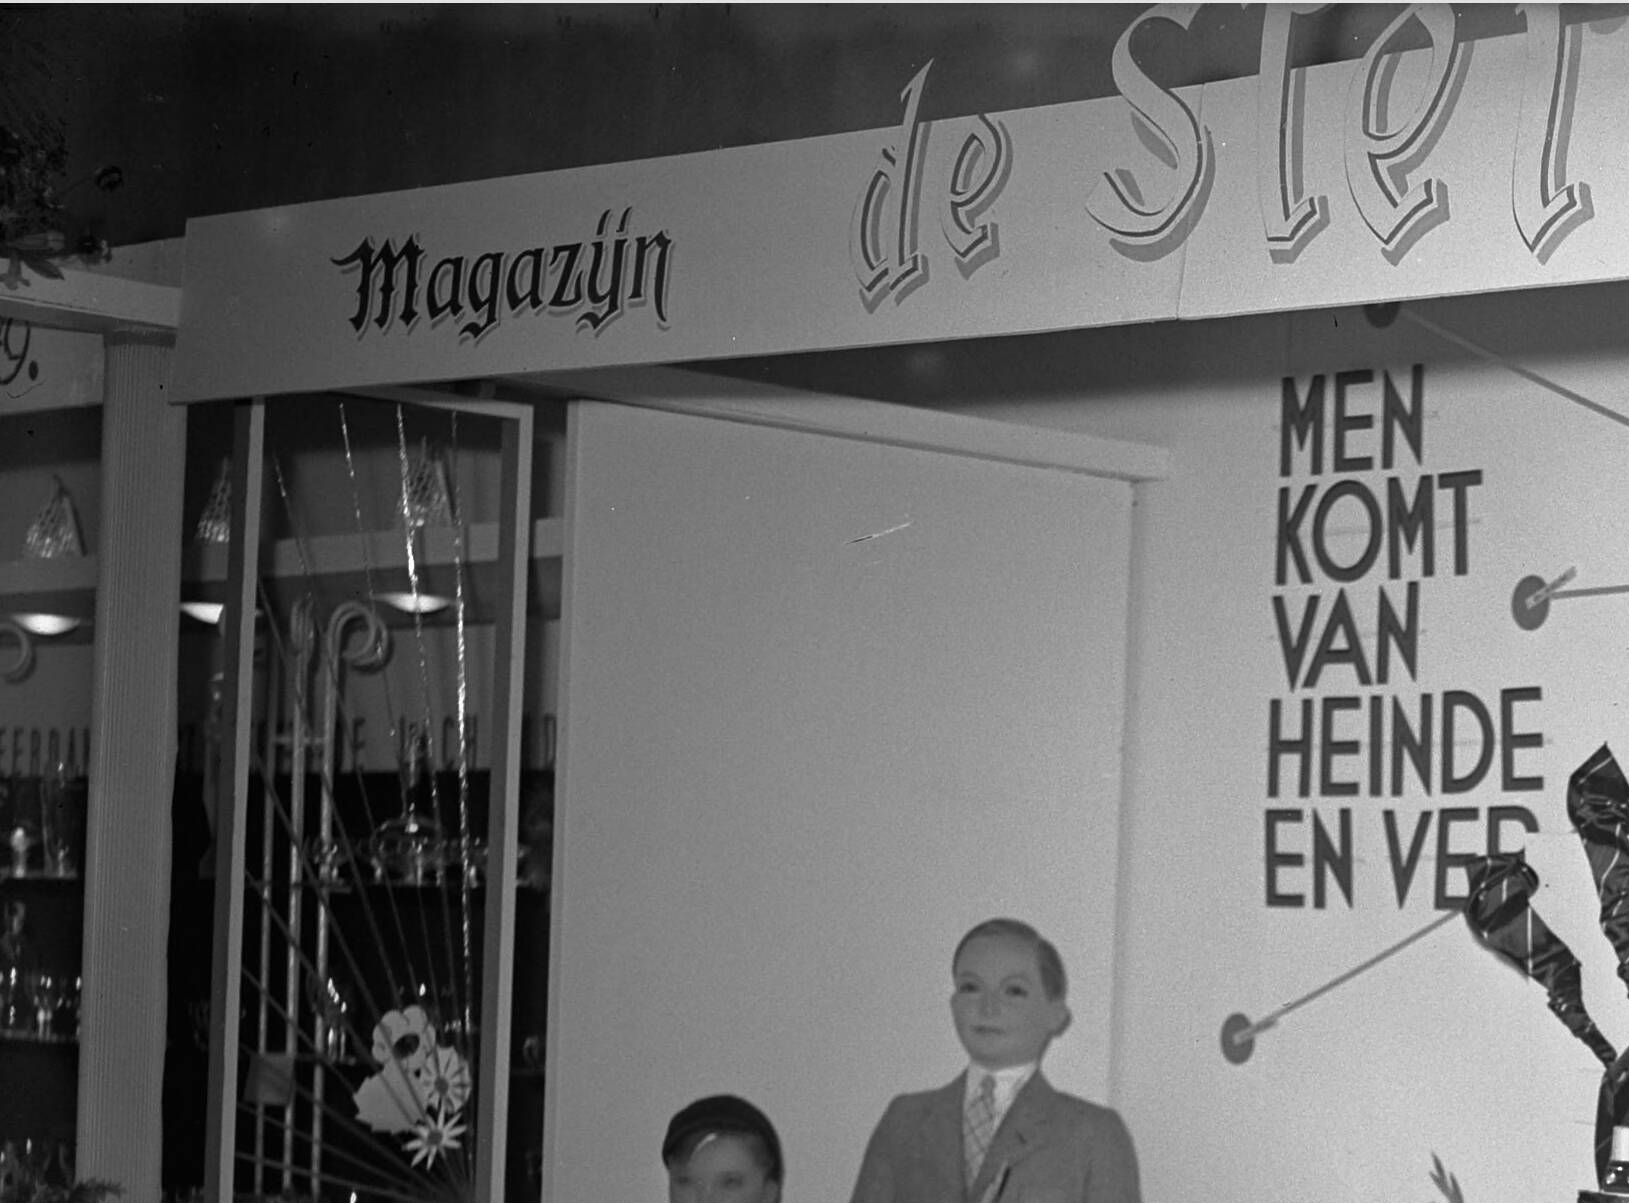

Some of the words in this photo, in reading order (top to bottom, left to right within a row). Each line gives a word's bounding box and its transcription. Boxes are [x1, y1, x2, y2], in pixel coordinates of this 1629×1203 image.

[849, 57, 1011, 312] de
[1280, 363, 1425, 478] MEN
[1275, 469, 1483, 586] KOMT
[1272, 581, 1420, 694] VAN
[1267, 686, 1545, 799] HEINDE
[1264, 807, 1354, 910] EN
